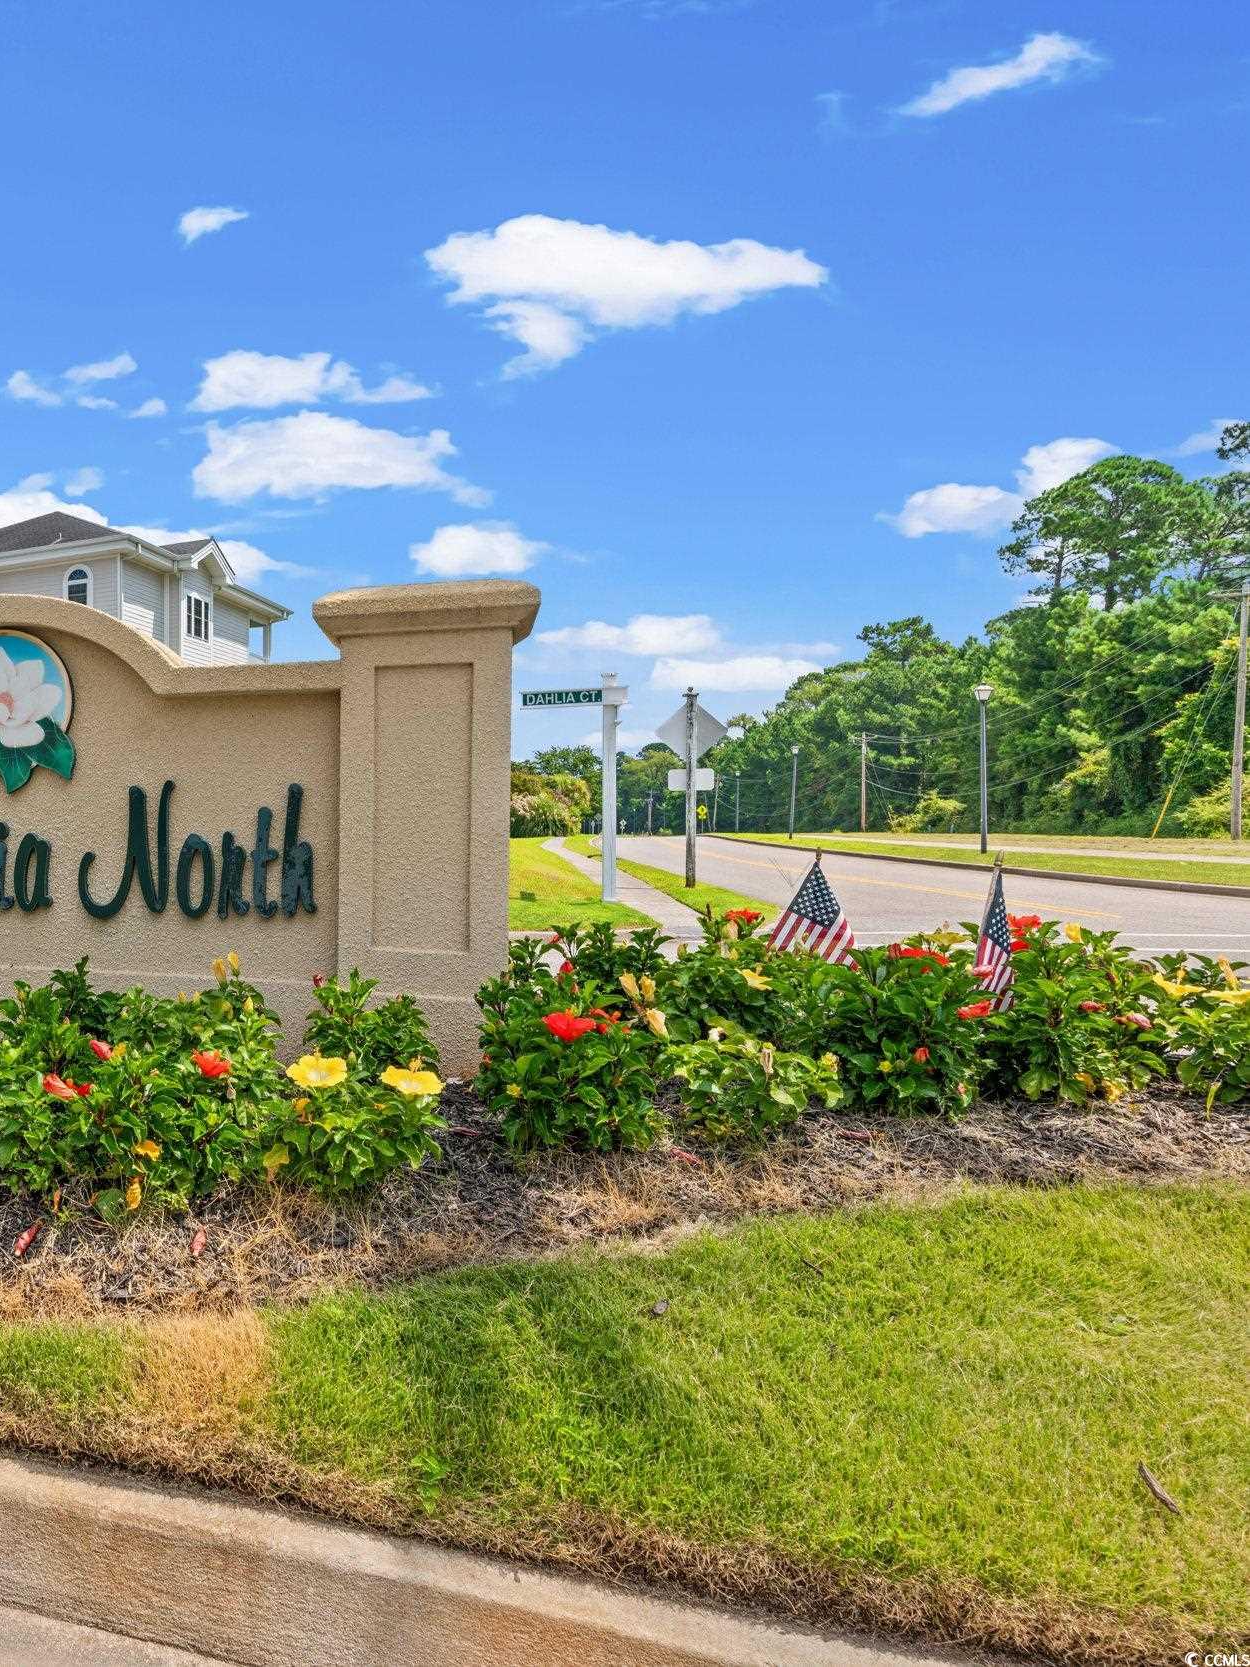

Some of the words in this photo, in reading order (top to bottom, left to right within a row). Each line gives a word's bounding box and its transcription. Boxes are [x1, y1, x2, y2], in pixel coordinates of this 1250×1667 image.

[526, 692, 576, 705] DAHLIA
[579, 691, 601, 703] CT.
[78, 780, 318, 918] North
